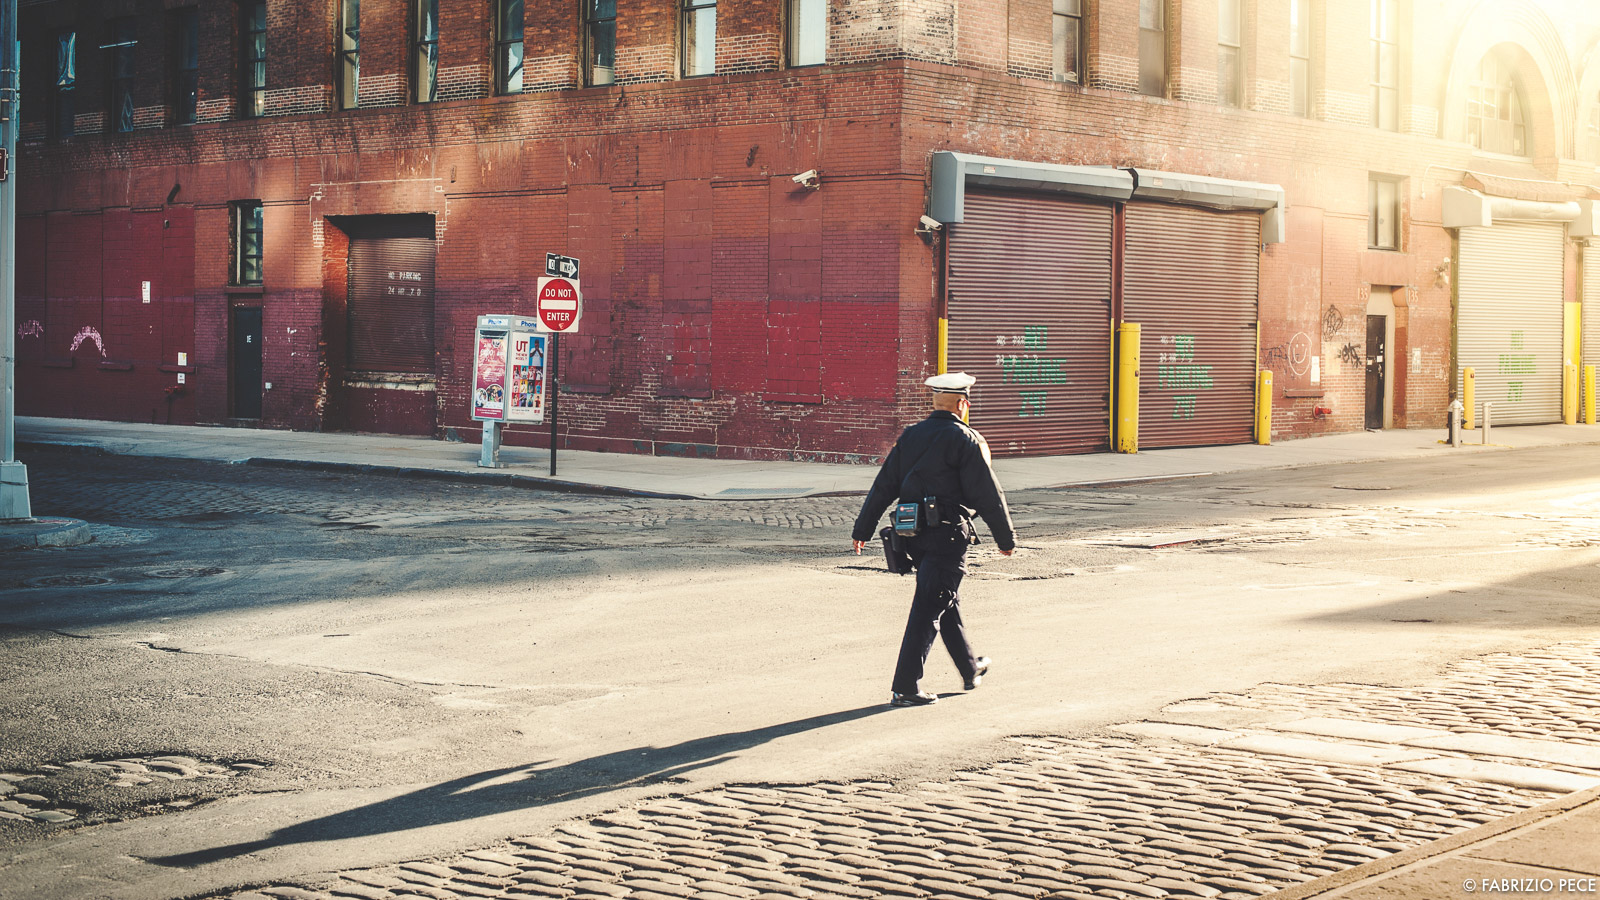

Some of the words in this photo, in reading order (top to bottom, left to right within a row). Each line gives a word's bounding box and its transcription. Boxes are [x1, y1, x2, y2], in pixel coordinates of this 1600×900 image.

[563, 263, 575, 272] WAY
[388, 271, 395, 280] NO
[399, 271, 422, 281] PARKING
[545, 288, 556, 298] DO
[558, 289, 572, 298] NOT
[1407, 288, 1419, 303] 135
[546, 312, 570, 321] ENTER
[1024, 325, 1047, 351] NO
[516, 340, 528, 352] UT
[1175, 334, 1195, 359] NO
[1002, 358, 1067, 385] PARKING
[1158, 365, 1213, 390] PARKING
